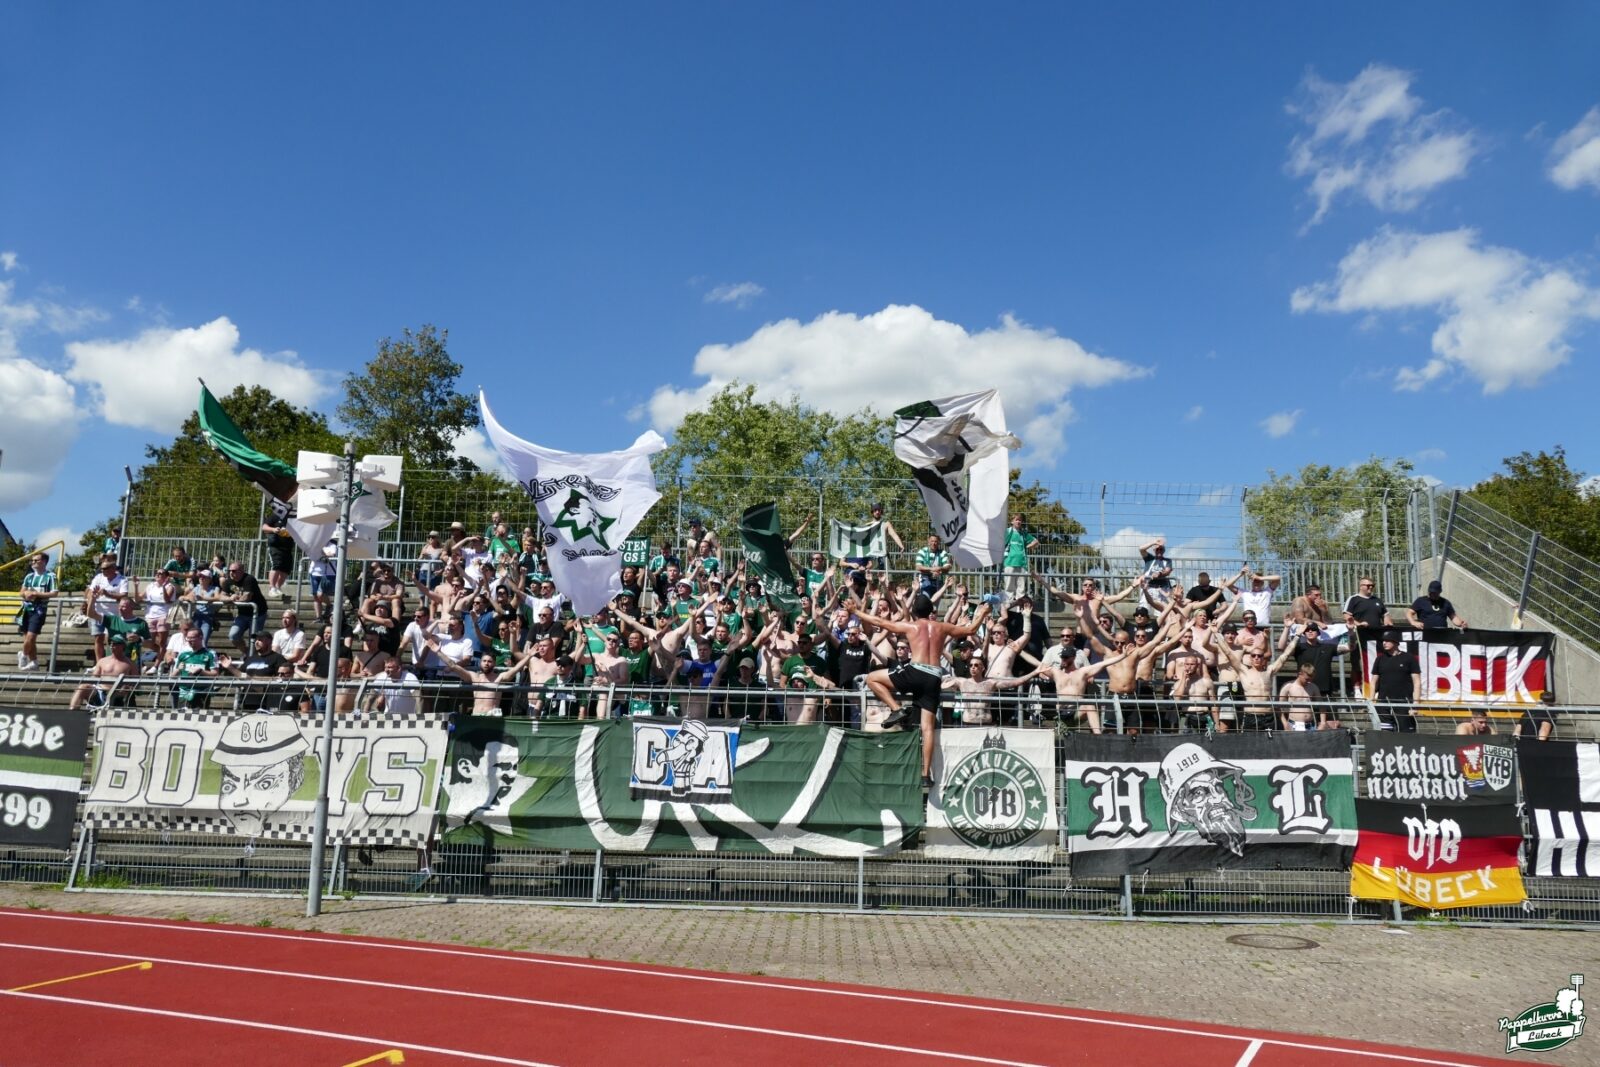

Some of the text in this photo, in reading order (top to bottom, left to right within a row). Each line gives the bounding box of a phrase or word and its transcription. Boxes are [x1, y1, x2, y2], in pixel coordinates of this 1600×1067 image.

[1176, 753, 1200, 772] 1919
[1370, 746, 1457, 776] sektion
[1485, 756, 1511, 779] VfB
[1366, 773, 1469, 801] neustadt
[1402, 816, 1463, 870] VfB
[1372, 856, 1498, 904] LÜBECK
